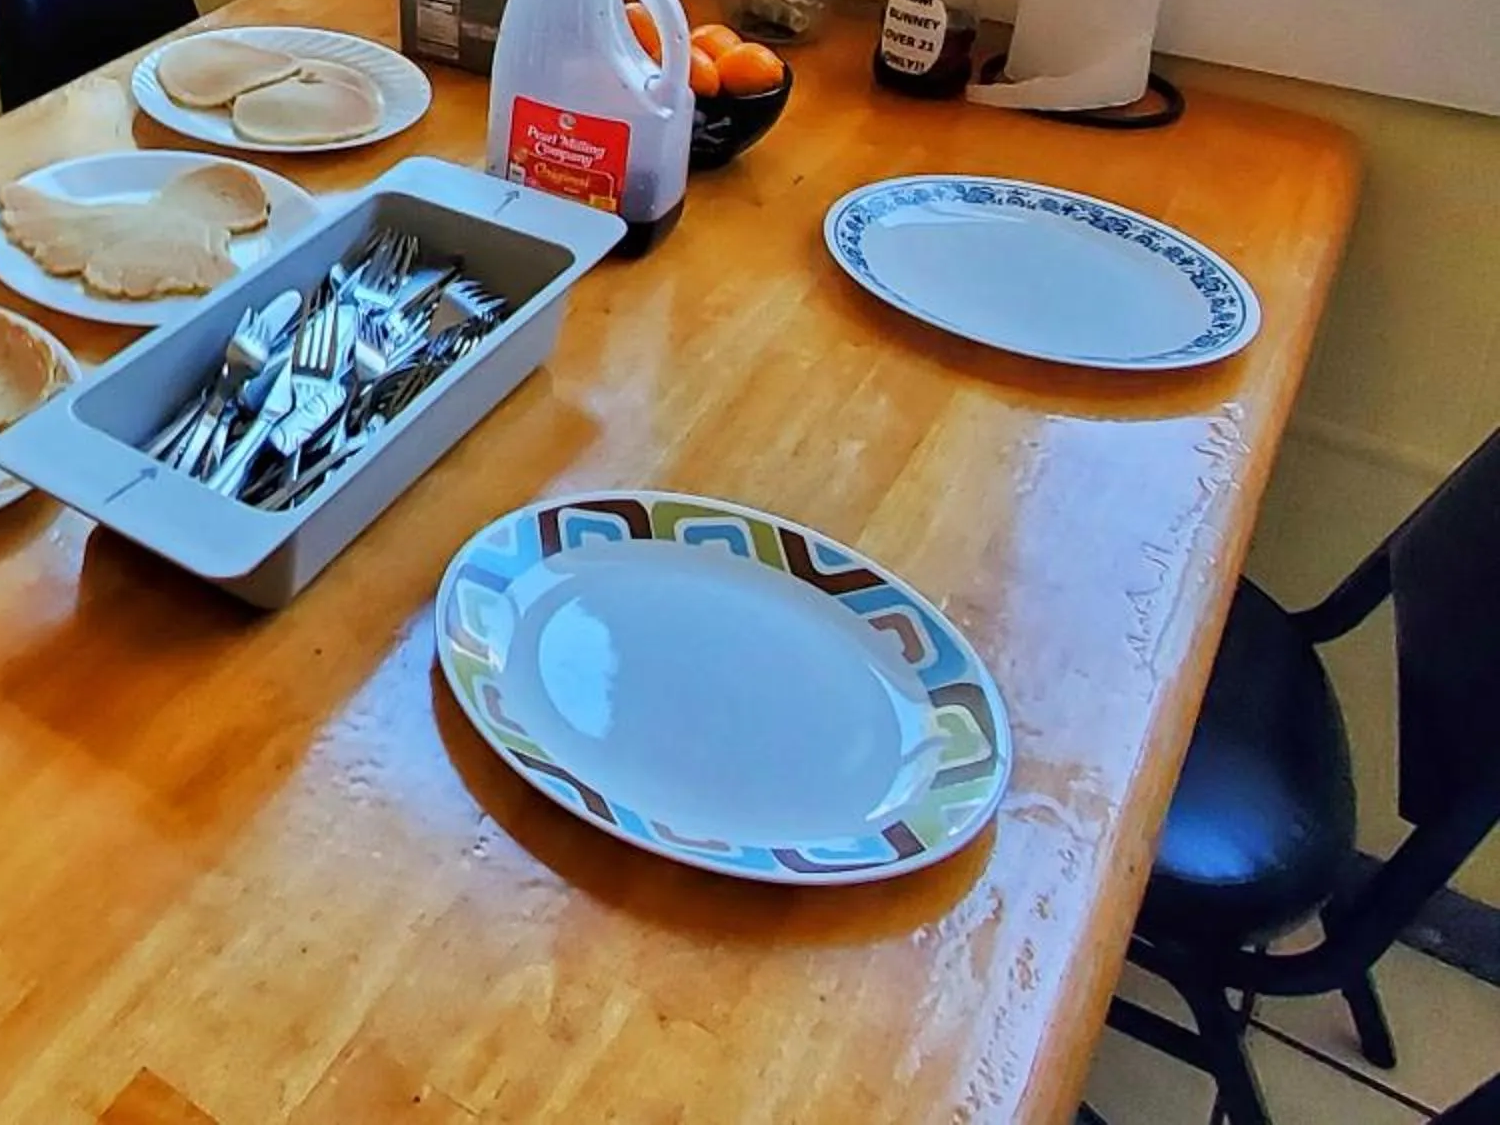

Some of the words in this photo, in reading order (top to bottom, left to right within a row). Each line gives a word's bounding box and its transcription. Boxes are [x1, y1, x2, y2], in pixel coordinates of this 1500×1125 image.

[885, 28, 916, 48] OVER
[918, 40, 935, 52] 21
[527, 124, 558, 146] Pearl
[534, 141, 594, 169] Company
